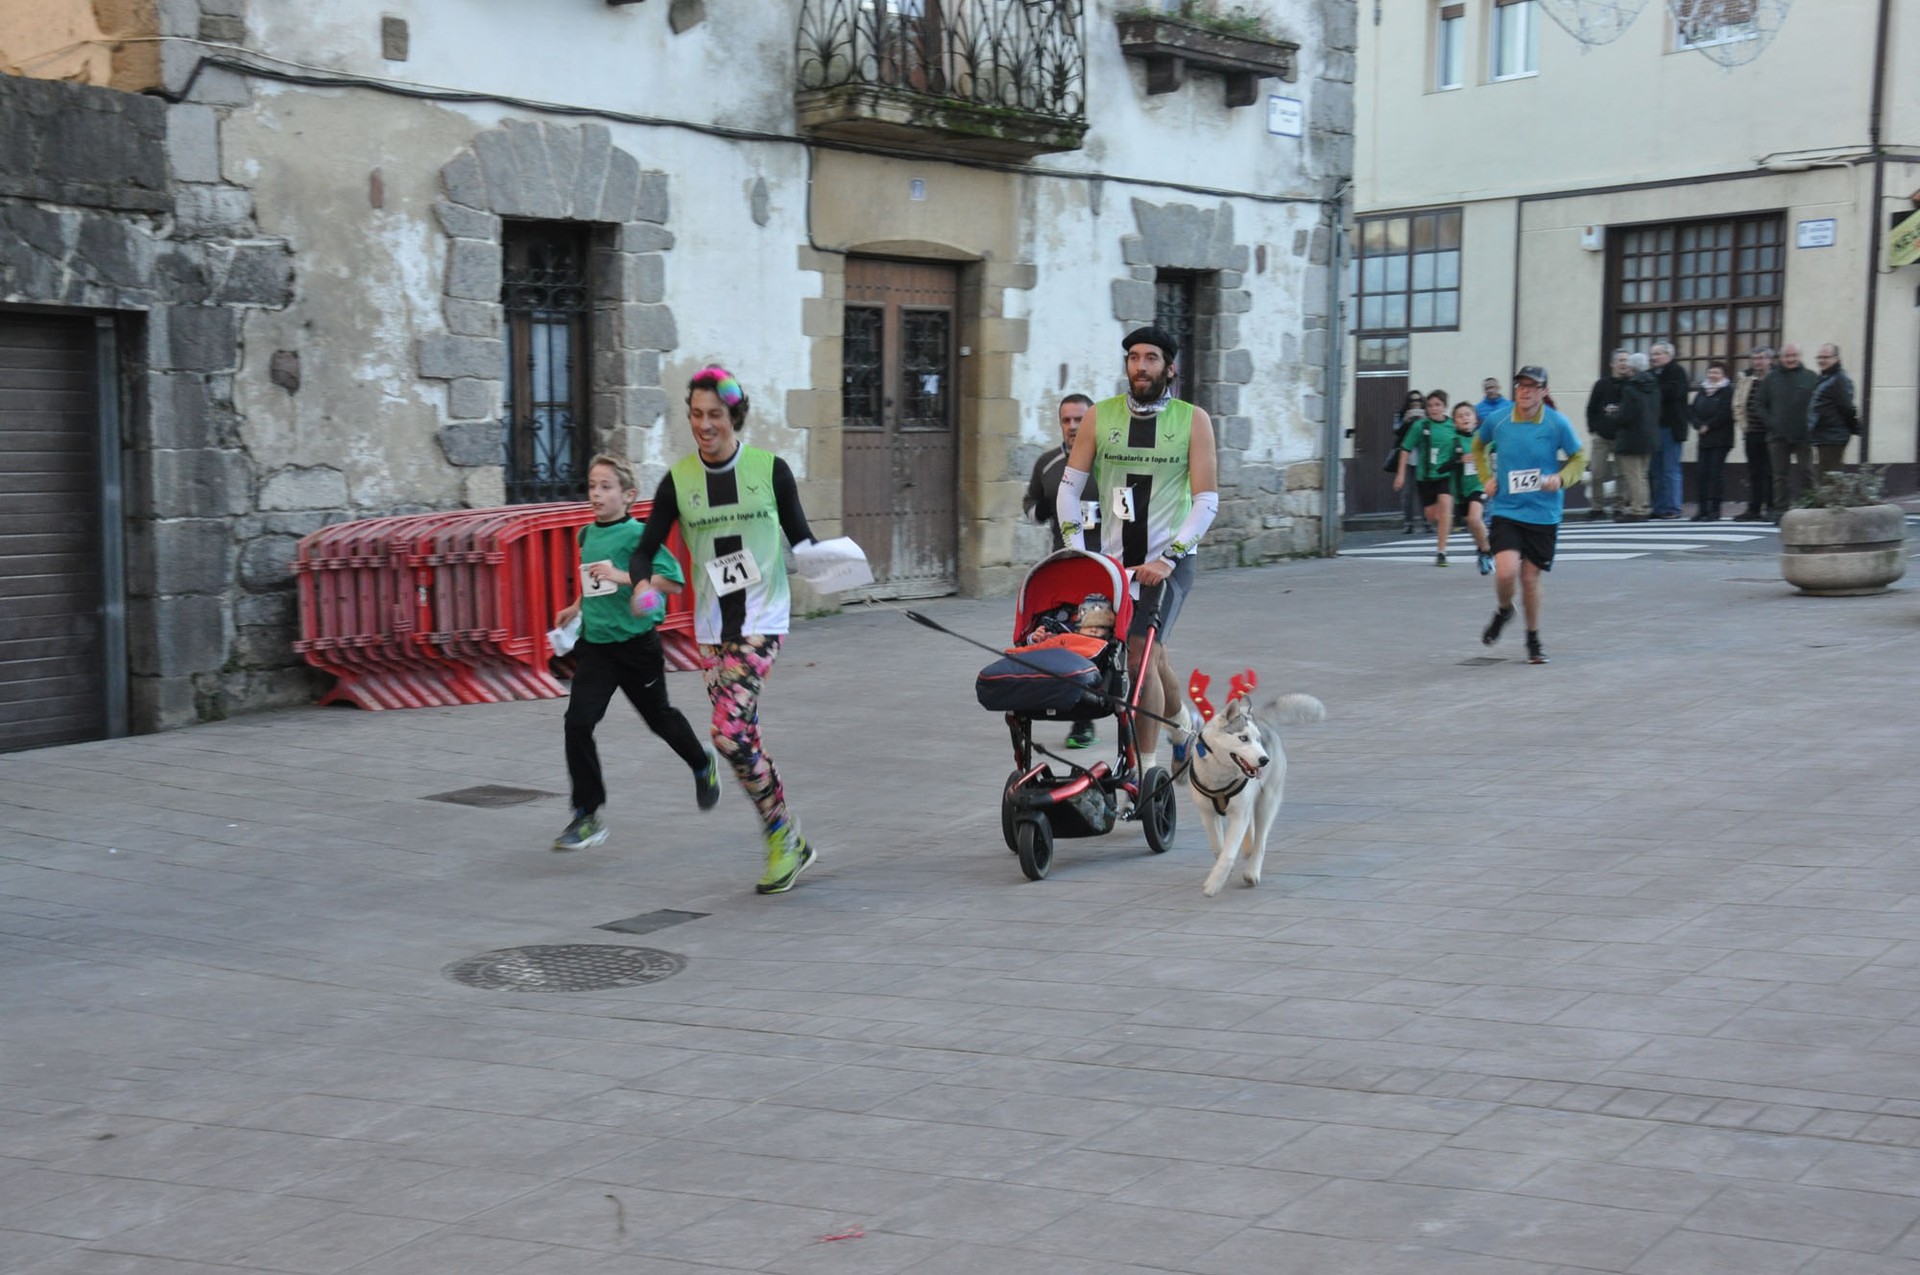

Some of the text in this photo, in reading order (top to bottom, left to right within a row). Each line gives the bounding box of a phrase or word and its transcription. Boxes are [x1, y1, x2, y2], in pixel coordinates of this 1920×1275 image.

[1104, 452, 1143, 463] Korrikalaris
[1151, 456, 1168, 464] tope
[1511, 475, 1538, 489] 149
[722, 561, 749, 585] 41
